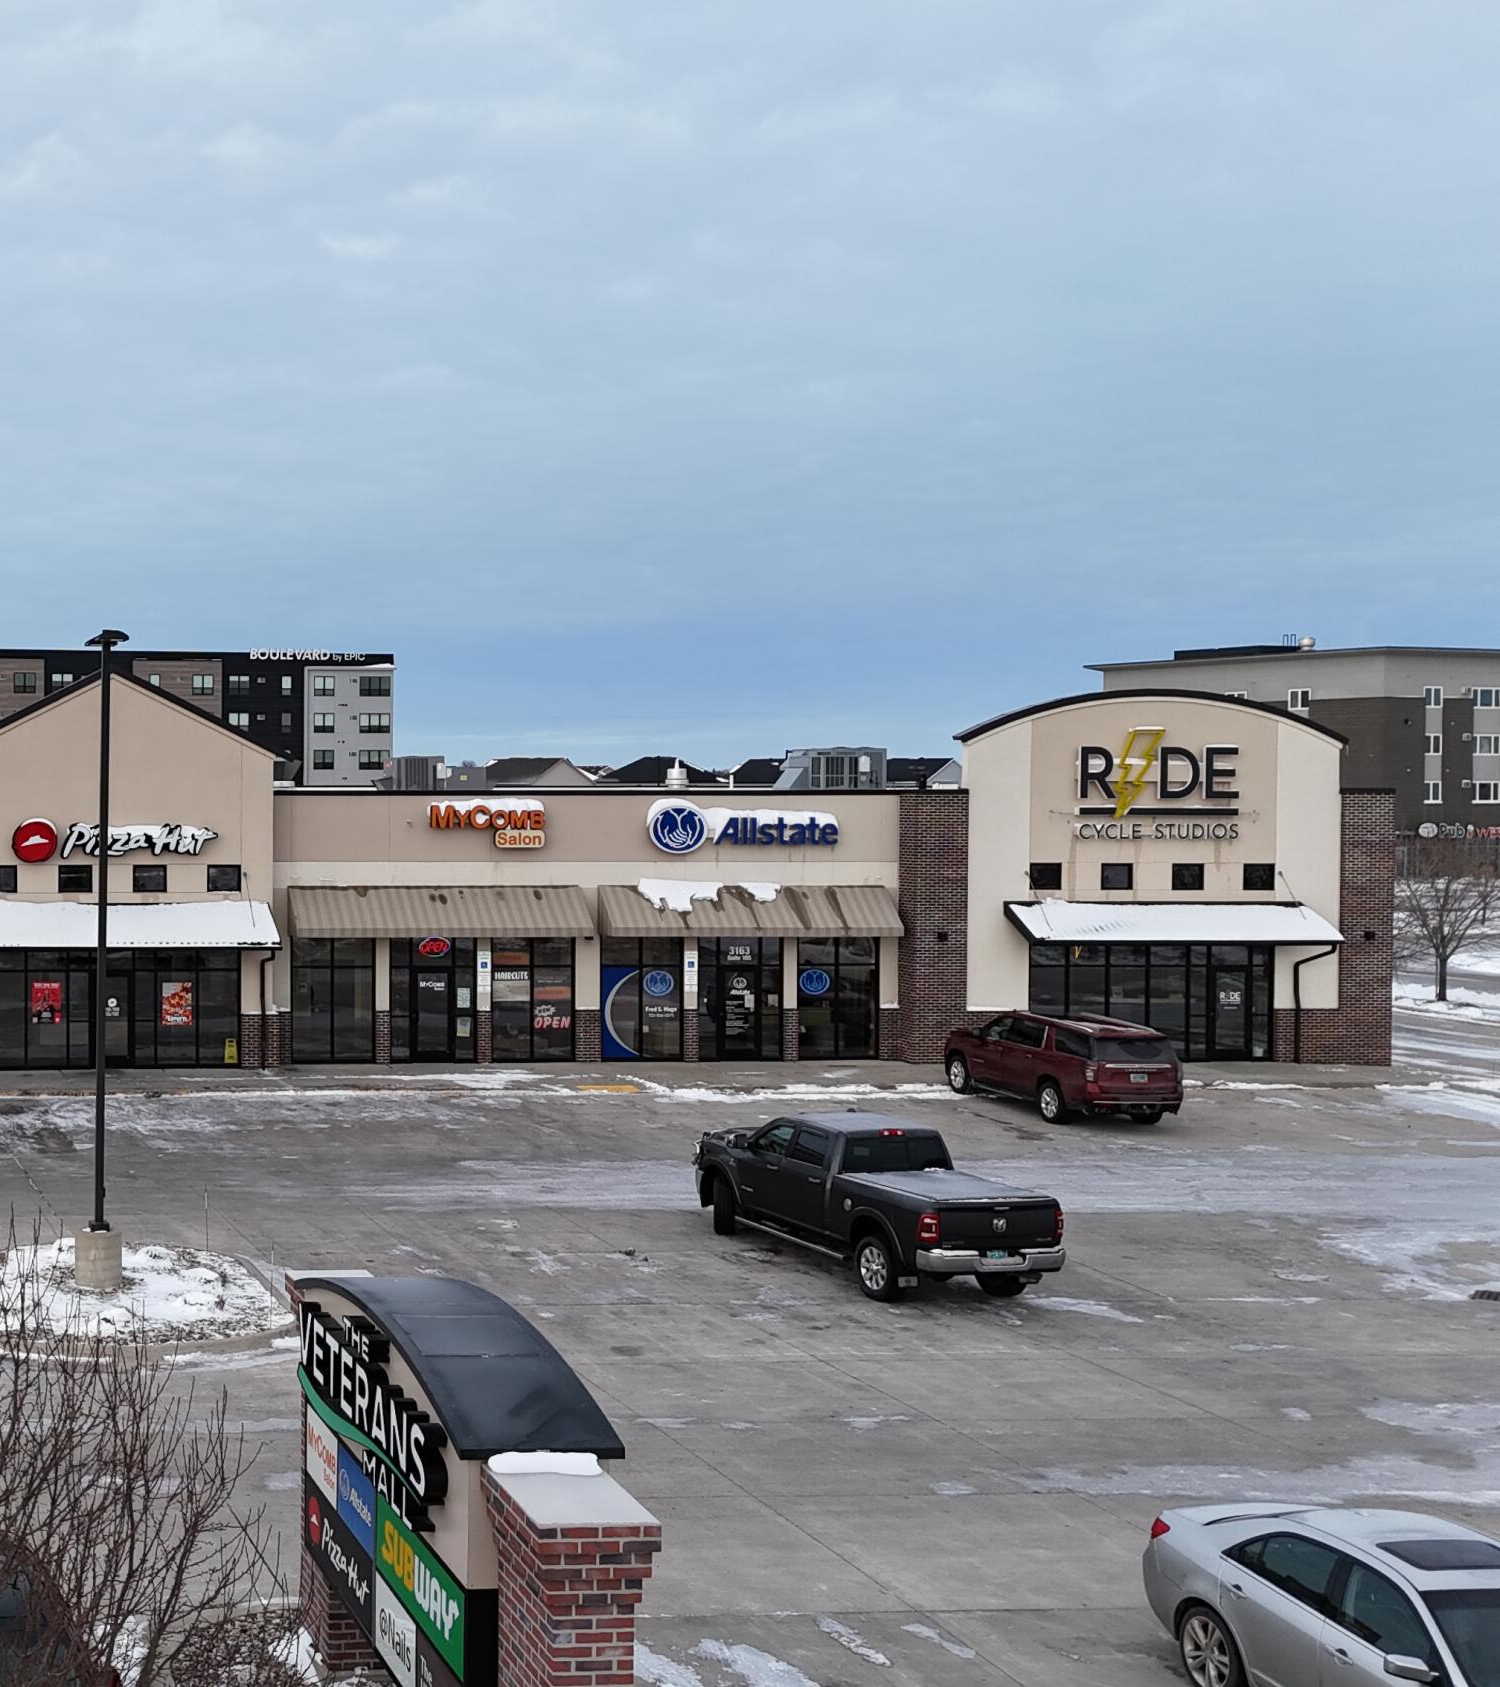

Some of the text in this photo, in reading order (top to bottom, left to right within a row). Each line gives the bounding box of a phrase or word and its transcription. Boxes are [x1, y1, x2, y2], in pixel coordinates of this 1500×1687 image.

[249, 648, 366, 663] BOULEVARD by EPIC
[497, 832, 542, 846] Salon
[714, 816, 839, 846] Allstate
[1078, 823, 1240, 840] CYCLE STUDIOS
[1439, 822, 1466, 839] Pub
[534, 1016, 571, 1029] OPEN
[343, 1316, 370, 1363] THE
[299, 1302, 426, 1497] VETERANS
[349, 1488, 372, 1528] Allstate
[362, 1450, 412, 1531] MALL
[321, 1517, 371, 1606] Pizza Hut
[381, 1520, 460, 1642] SUBWAY
[379, 1608, 412, 1672] @Nails
